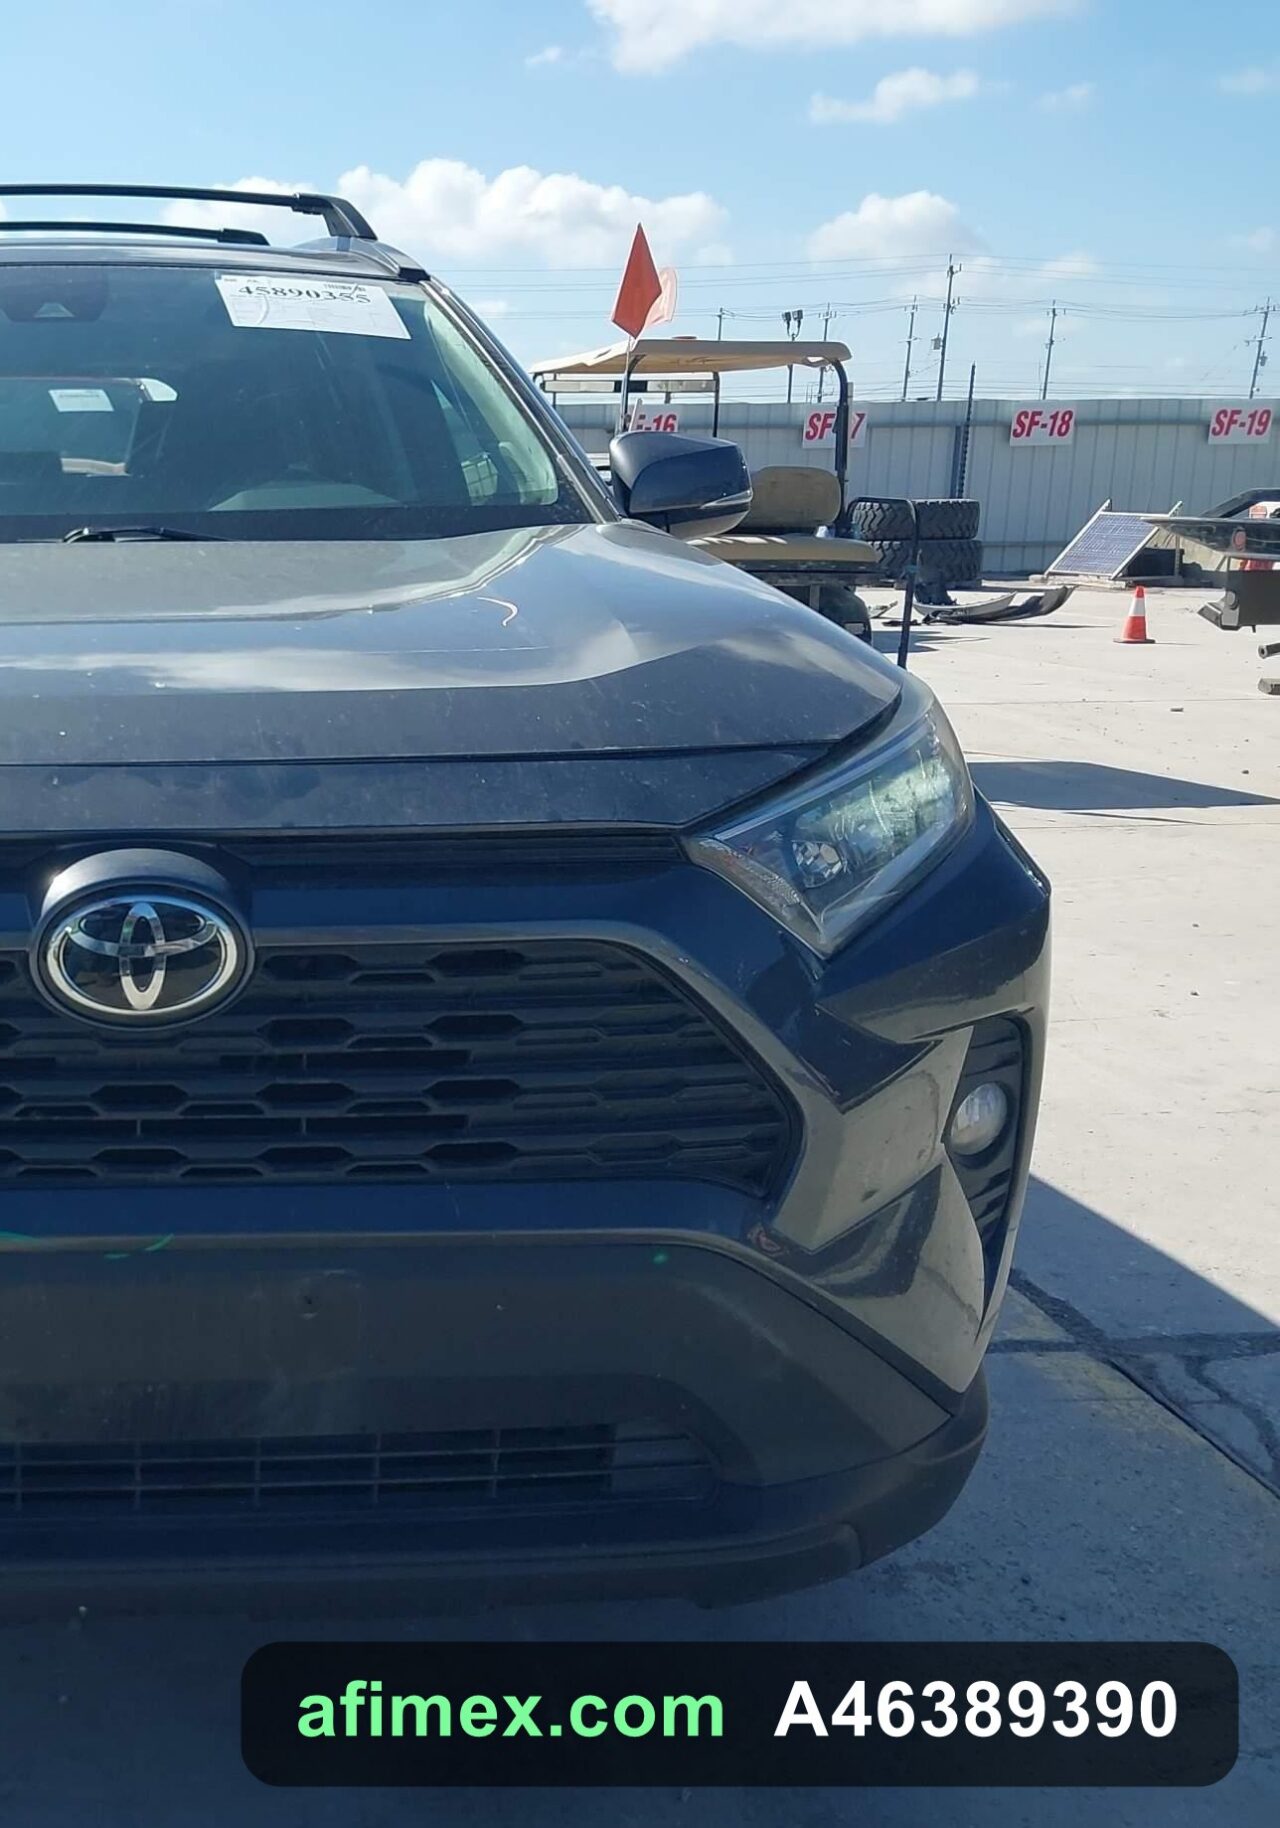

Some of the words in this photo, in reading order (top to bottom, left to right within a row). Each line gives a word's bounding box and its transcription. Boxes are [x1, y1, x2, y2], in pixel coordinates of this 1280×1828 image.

[805, 412, 866, 441] SF7
[1012, 410, 1074, 438] SF-18
[1211, 409, 1272, 436] SF-19
